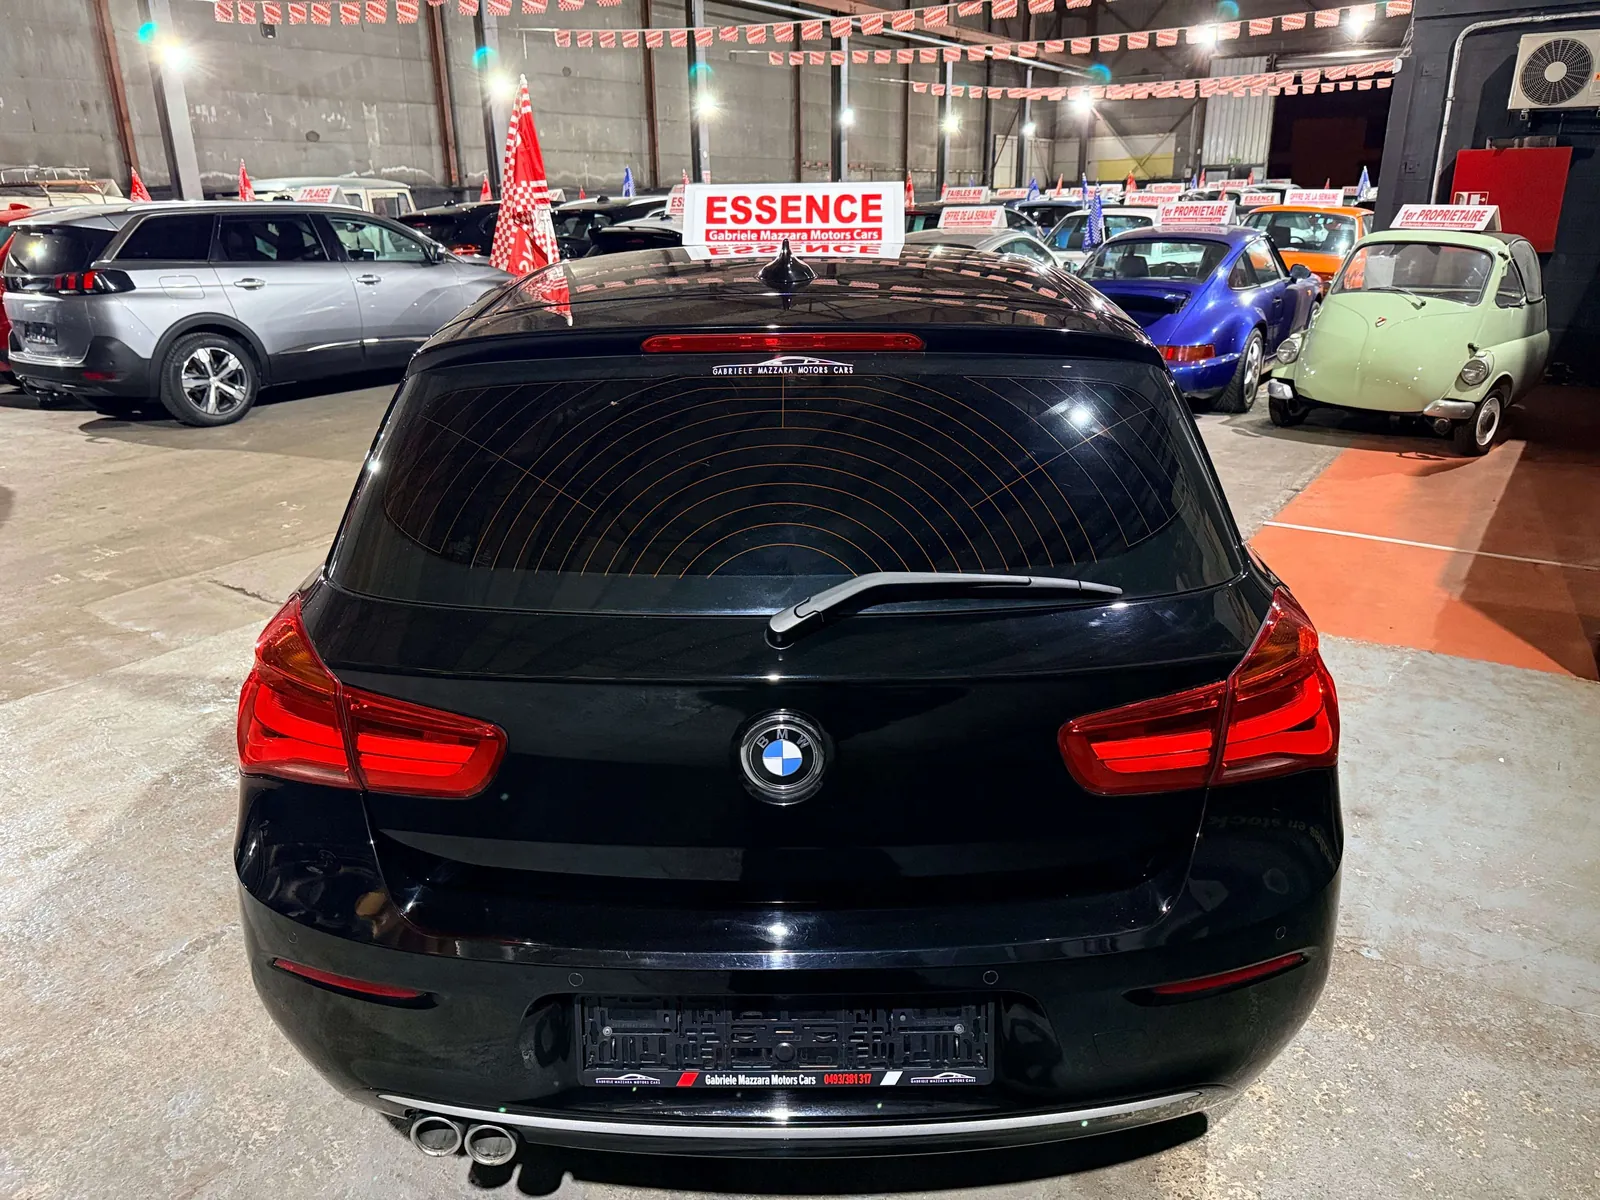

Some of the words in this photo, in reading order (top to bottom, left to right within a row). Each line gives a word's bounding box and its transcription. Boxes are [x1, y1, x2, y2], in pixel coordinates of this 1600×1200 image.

[947, 189, 971, 197] FAIBLES
[706, 194, 883, 225] ESSENCE
[1161, 206, 1173, 217] 1er
[1173, 205, 1228, 217] PROPRIETAIRE
[1401, 209, 1418, 221] 1er
[1415, 209, 1488, 222] PROPRIETAIRE
[709, 229, 757, 241] Gabriele
[760, 229, 808, 241] Mazzara
[811, 229, 851, 240] Motors
[853, 228, 879, 240] Cars
[712, 367, 752, 375] GABRIELE
[757, 366, 793, 375] MAZZARA
[798, 366, 828, 374] MOTORS
[834, 366, 854, 374] CARS
[756, 728, 810, 749] BMW
[705, 1074, 737, 1086] Gabriele
[738, 1074, 770, 1085] Mazzara
[771, 1074, 798, 1085] Motors
[798, 1074, 817, 1085] Cars
